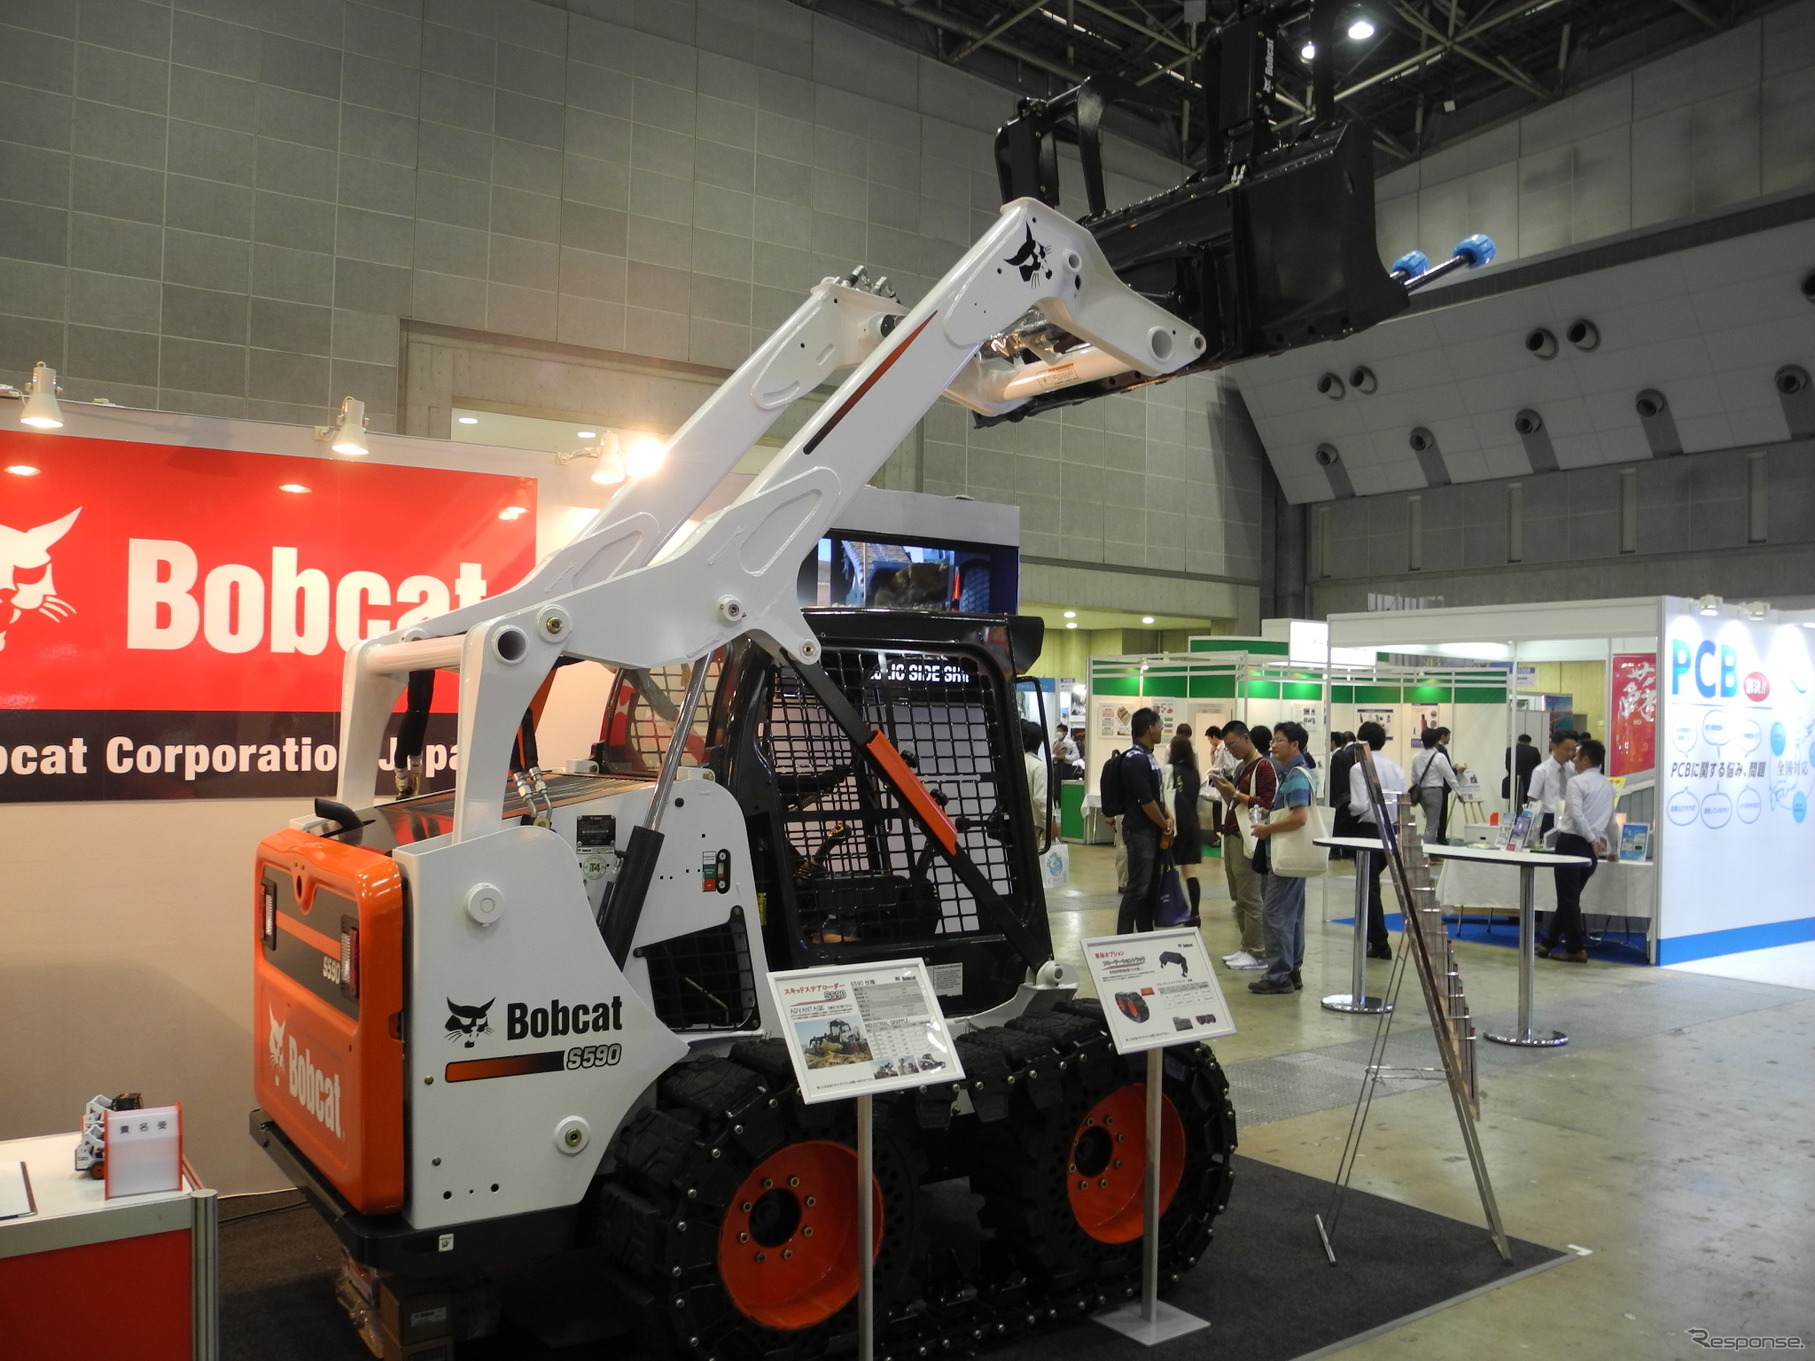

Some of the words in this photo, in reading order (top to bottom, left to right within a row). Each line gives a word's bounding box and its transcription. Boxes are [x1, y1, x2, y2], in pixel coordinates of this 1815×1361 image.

[1265, 37, 1274, 77] Bobcat
[908, 664, 940, 682] SIDE
[1671, 638, 1738, 699] PCB
[106, 735, 338, 781] Corporatio
[1671, 761, 1767, 779] PCBに関する悩み、問題
[1777, 760, 1809, 777] 全国対応
[321, 955, 341, 985] S590
[824, 989, 847, 1000] S590
[507, 995, 623, 1041] Bobcat
[566, 1042, 622, 1071] S590
[288, 1035, 342, 1138] Bobcat
